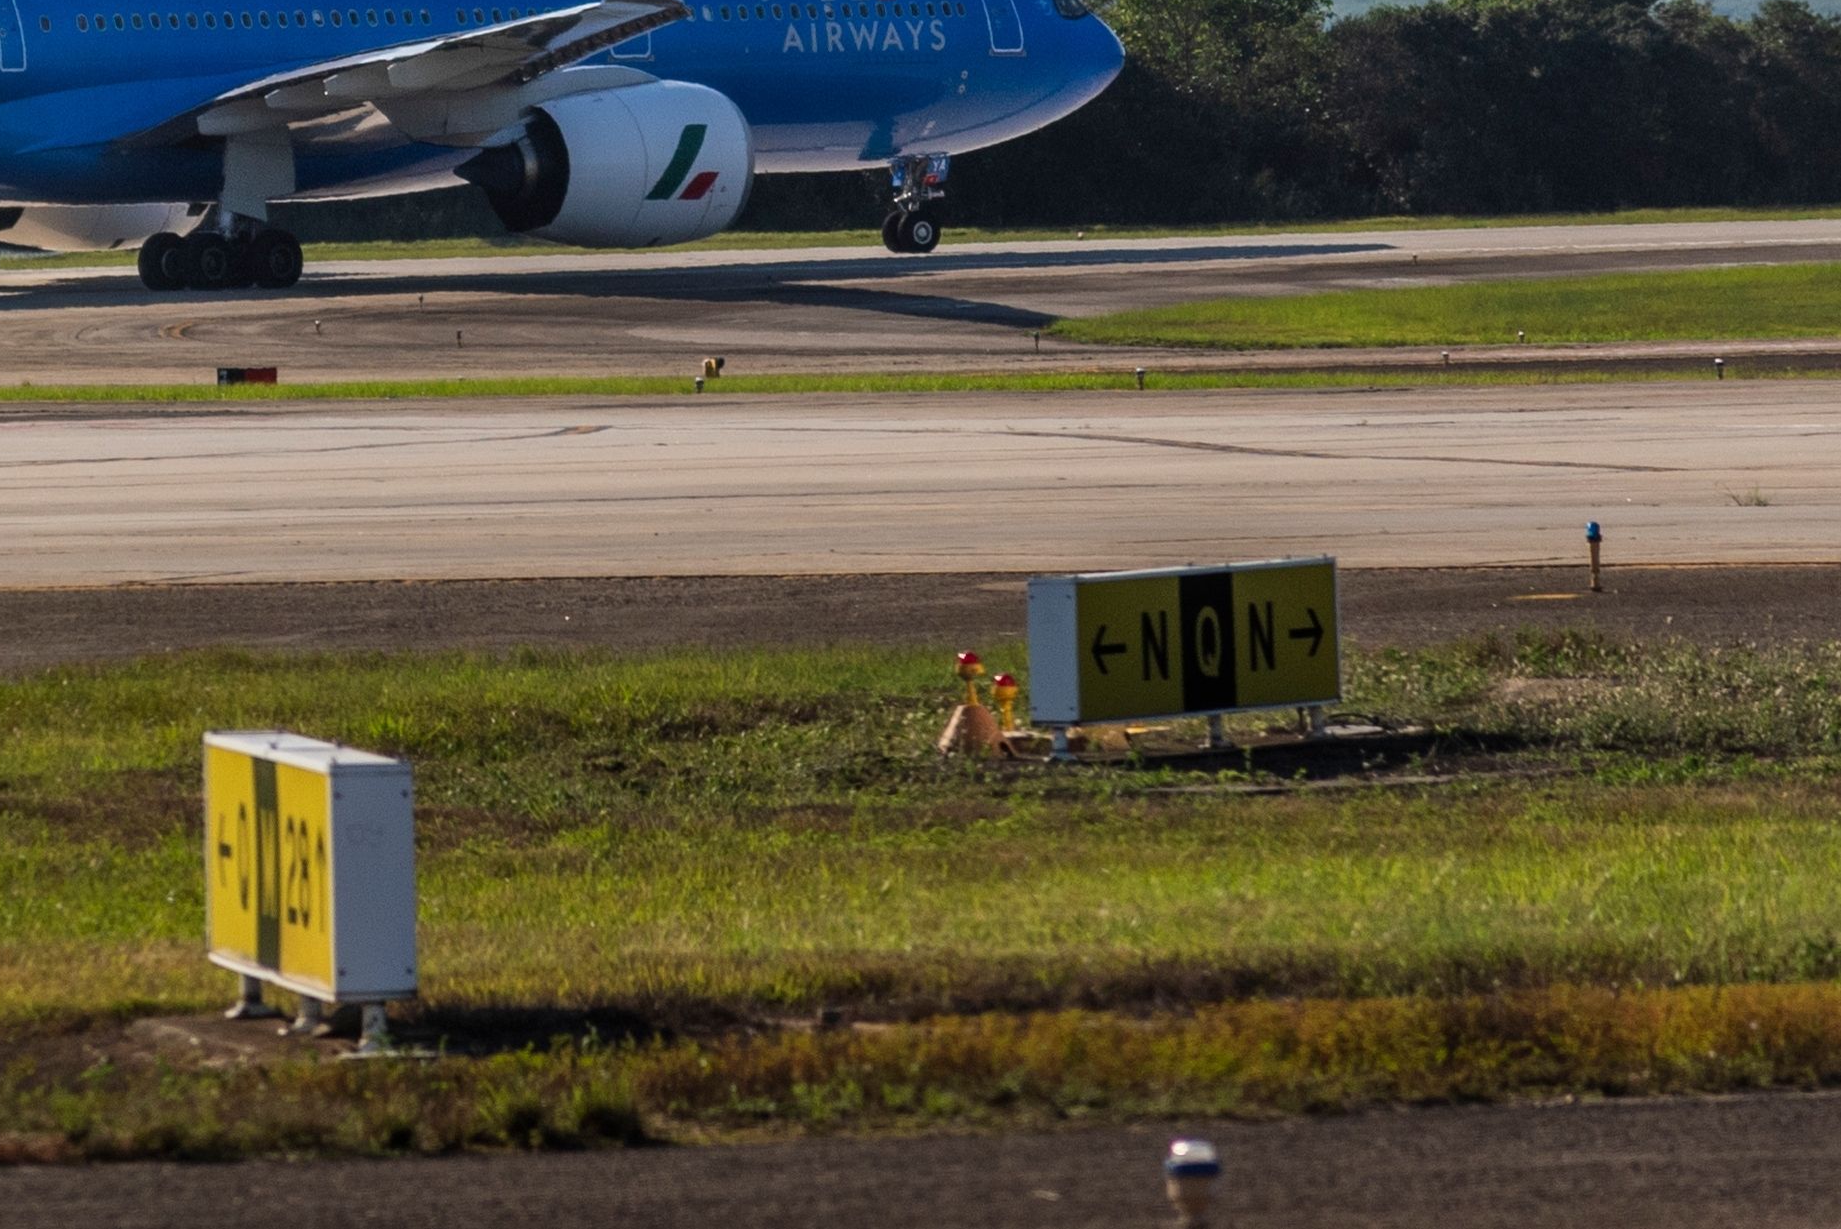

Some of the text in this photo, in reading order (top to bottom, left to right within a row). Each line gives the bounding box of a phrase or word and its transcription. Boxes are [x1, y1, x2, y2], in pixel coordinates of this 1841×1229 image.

[782, 19, 947, 54] AIRWAYS
[932, 158, 947, 172] YA
[1141, 600, 1276, 681] N Q N
